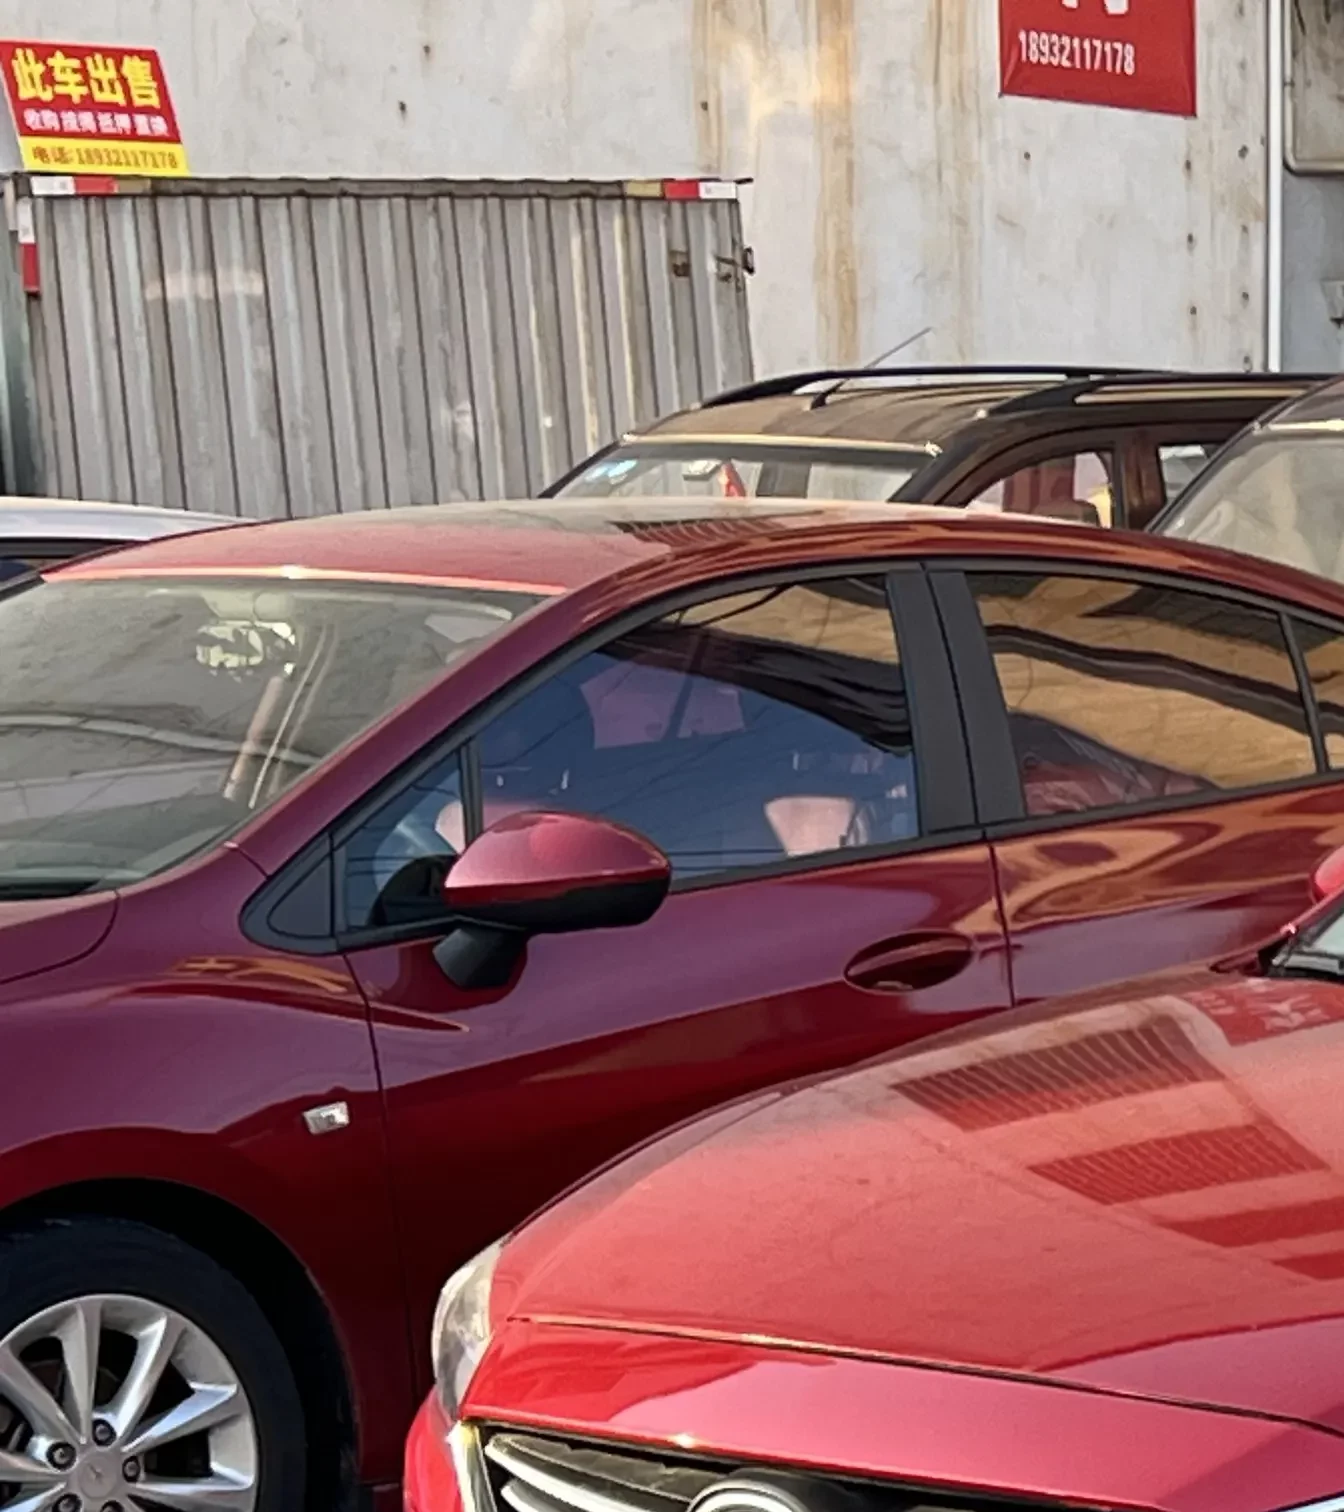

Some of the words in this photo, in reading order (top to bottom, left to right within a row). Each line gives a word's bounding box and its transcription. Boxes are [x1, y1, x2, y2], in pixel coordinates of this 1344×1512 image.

[12, 47, 161, 108] 此车出售
[1018, 28, 1136, 76] 18932117178
